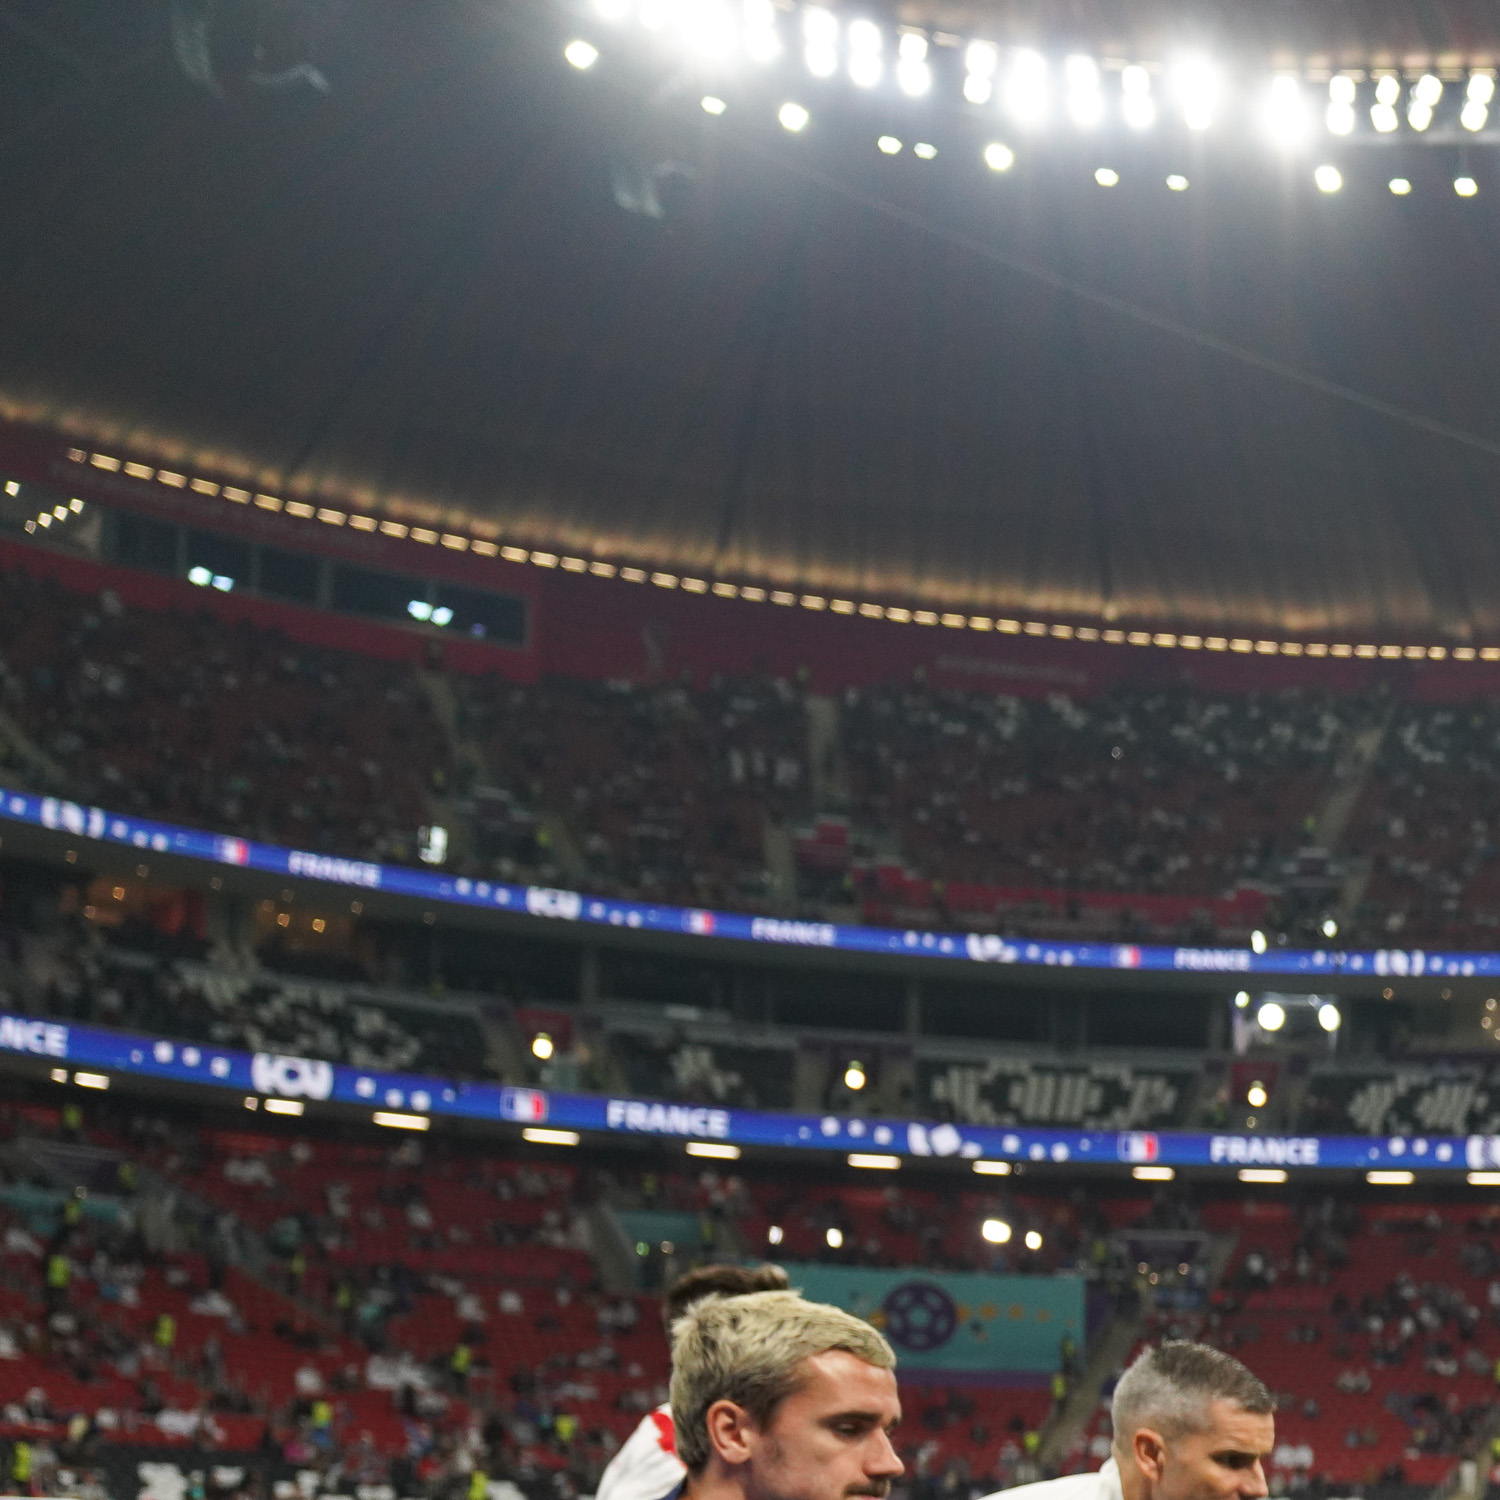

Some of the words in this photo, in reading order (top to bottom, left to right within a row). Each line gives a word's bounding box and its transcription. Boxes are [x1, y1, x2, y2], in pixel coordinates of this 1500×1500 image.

[288, 851, 381, 888] FRANCE
[751, 918, 837, 947] FRANCE
[1173, 948, 1252, 972] FRANCE
[607, 1099, 730, 1139] FRANCE
[1210, 1135, 1320, 1166] FRANCE
